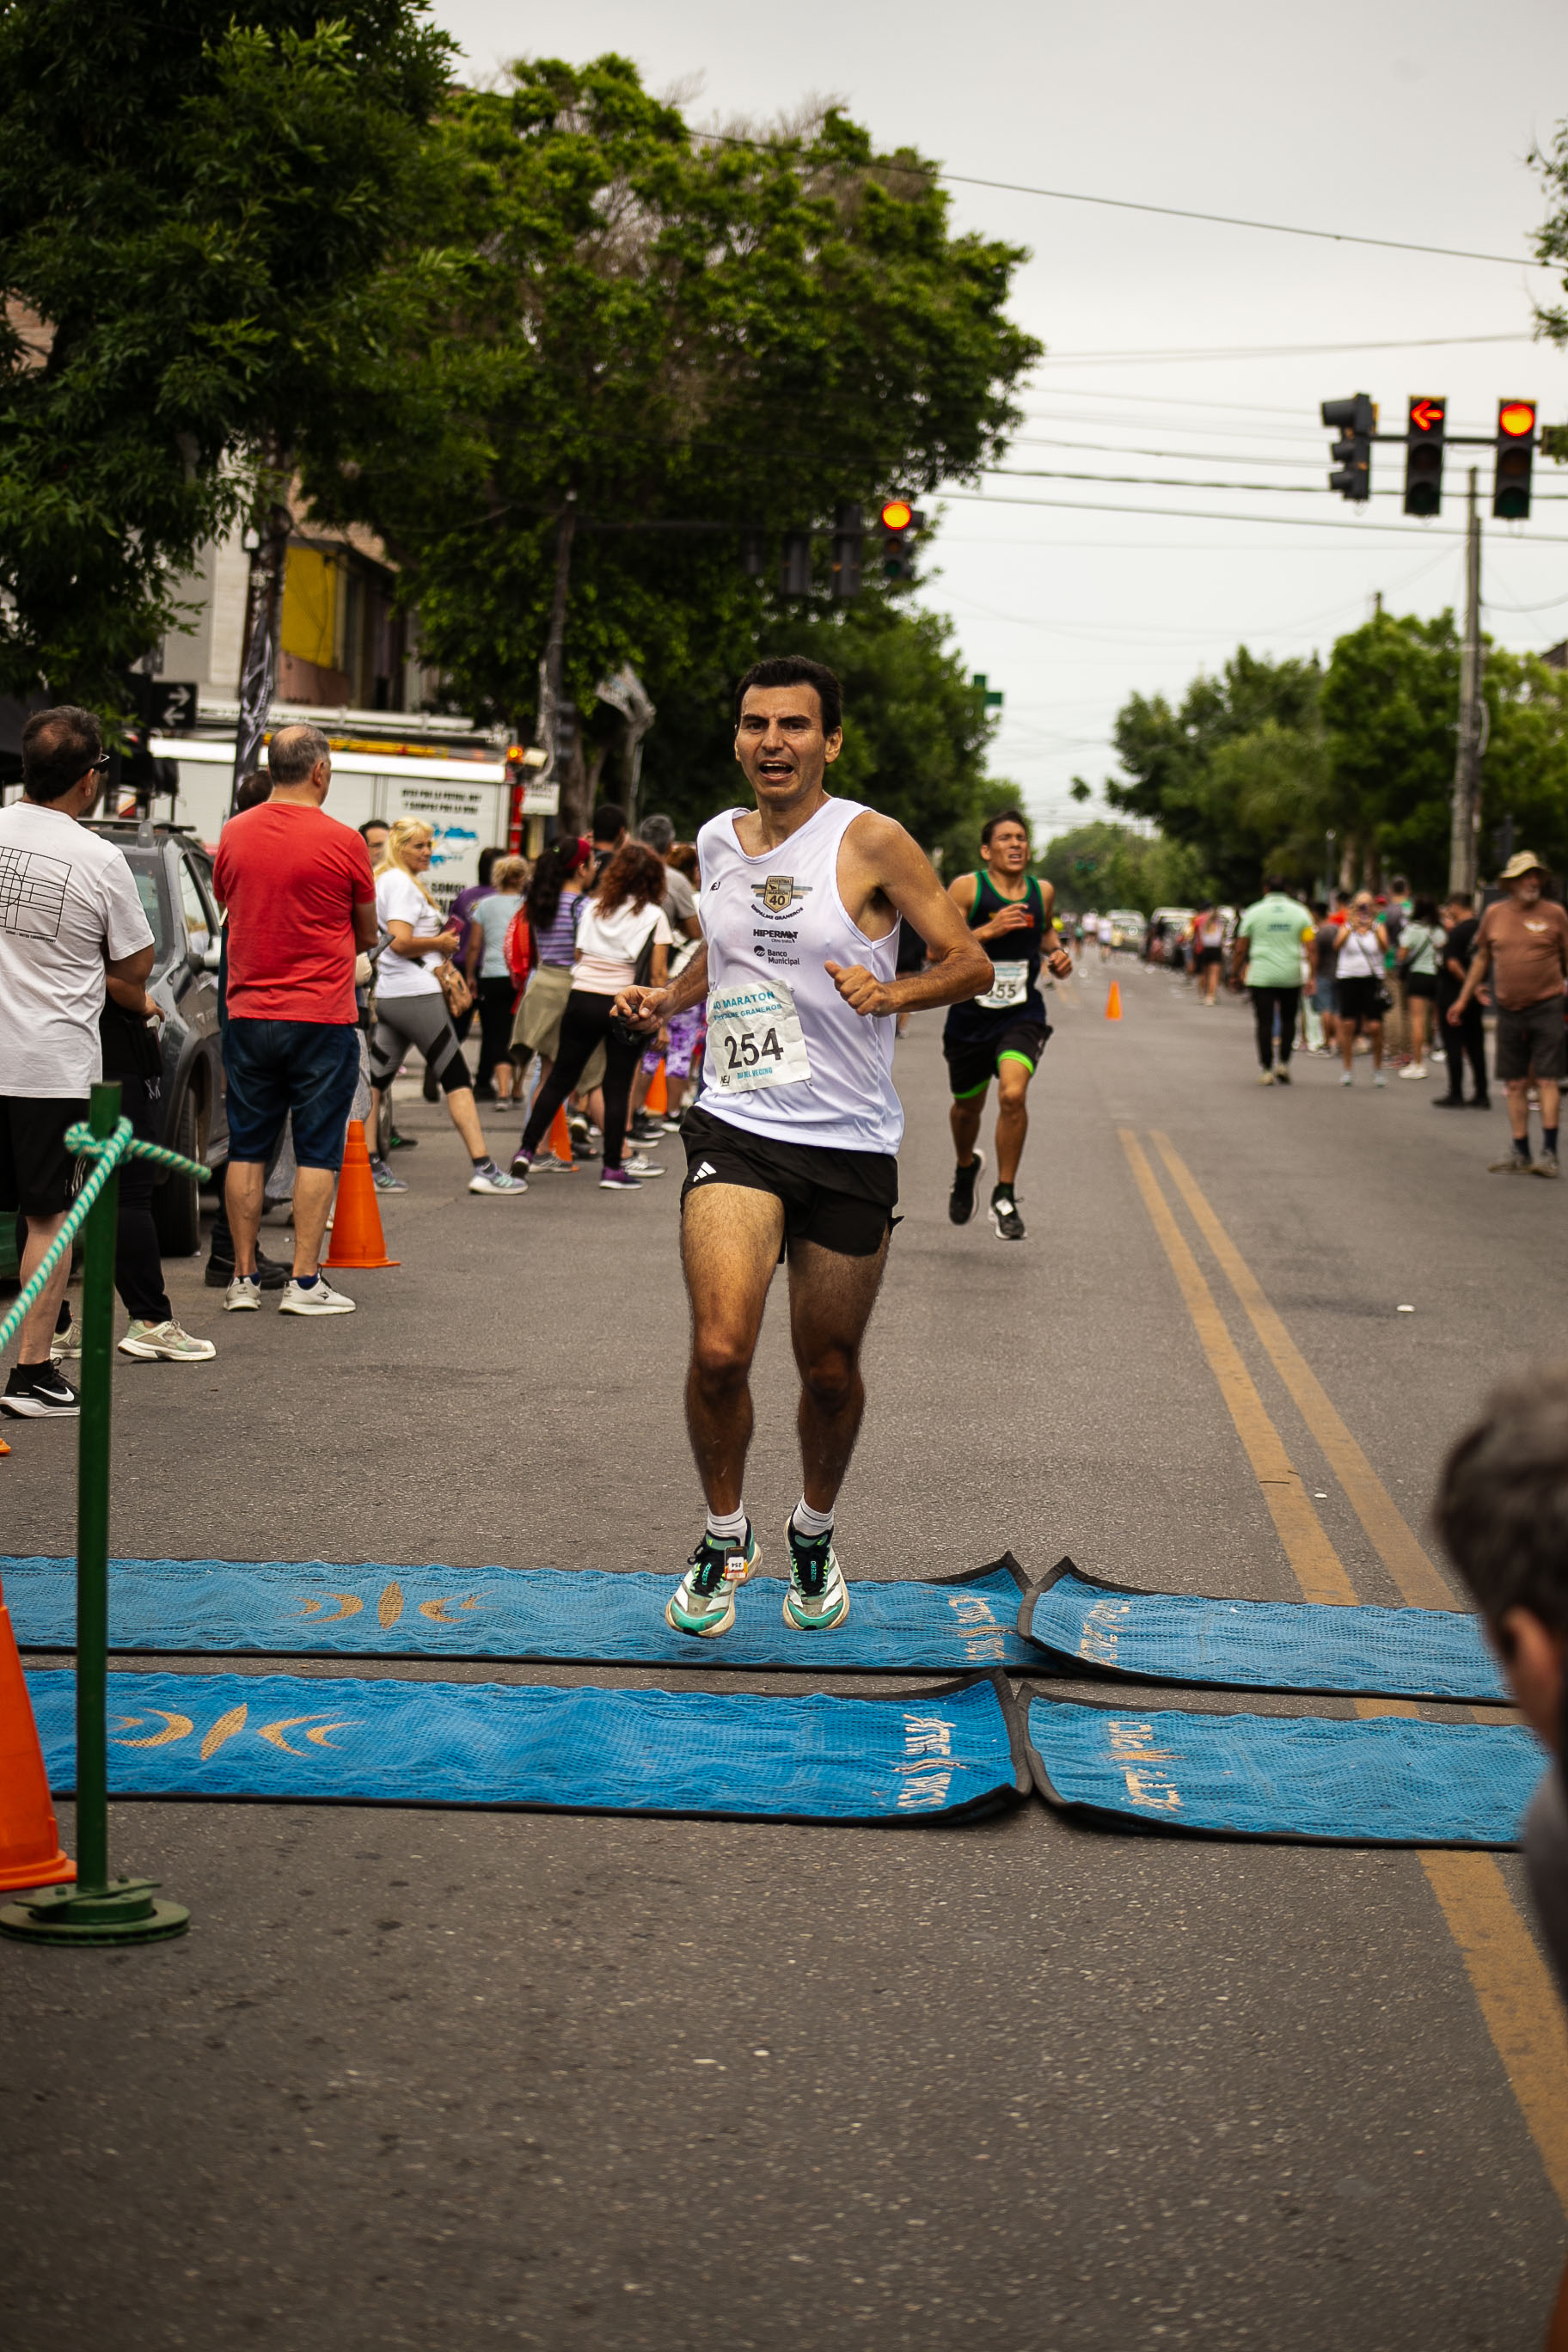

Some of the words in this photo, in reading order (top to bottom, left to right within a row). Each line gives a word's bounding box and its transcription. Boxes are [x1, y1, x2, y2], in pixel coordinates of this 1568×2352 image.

[769, 896, 786, 906] 40
[750, 903, 774, 920] EMPALME
[775, 906, 804, 921] GRANEROS
[768, 957, 800, 965] Municipal
[722, 990, 775, 1008] MARATON
[741, 1003, 783, 1017] GRANEROS
[724, 1027, 784, 1069] 254
[751, 1066, 773, 1077] VECINO
